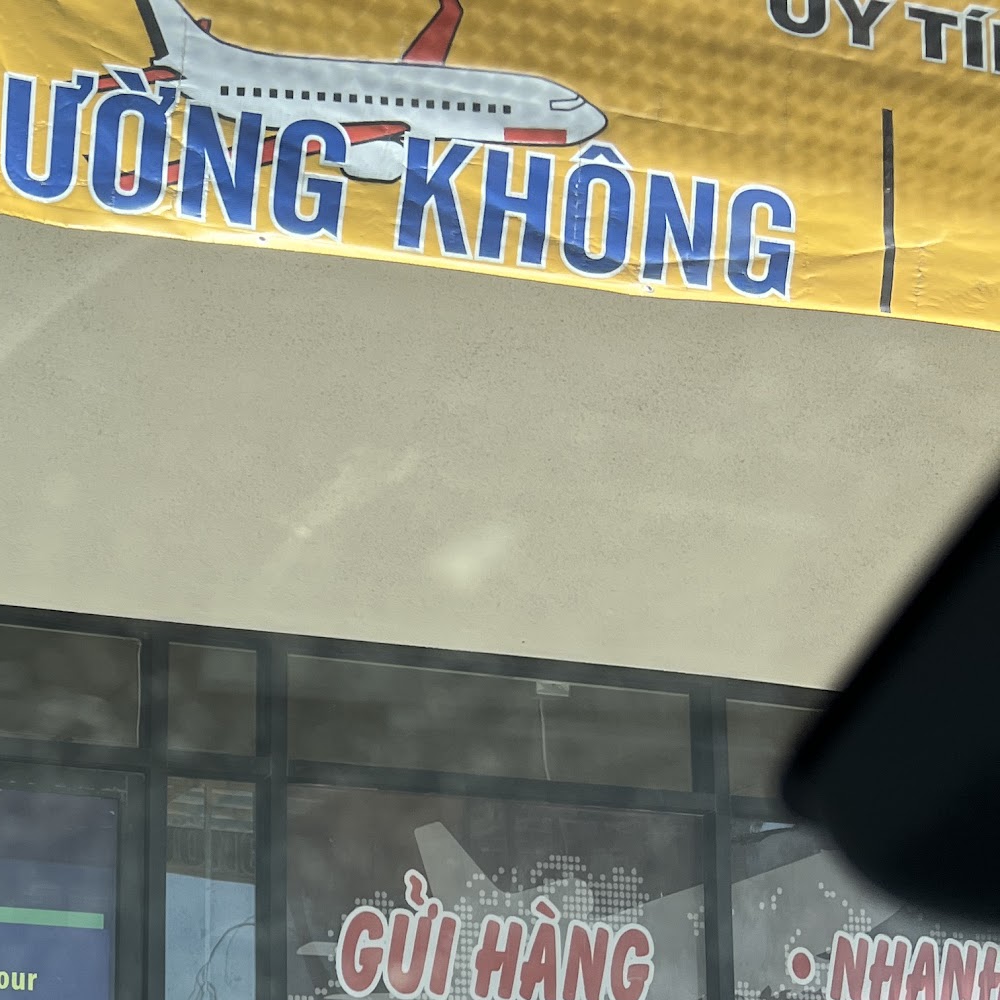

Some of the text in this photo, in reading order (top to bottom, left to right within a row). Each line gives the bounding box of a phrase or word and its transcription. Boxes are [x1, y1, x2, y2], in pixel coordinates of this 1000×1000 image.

[904, 2, 1000, 76] TÍ
[394, 140, 797, 301] KHÔNG
[337, 869, 460, 1000] GỬI
